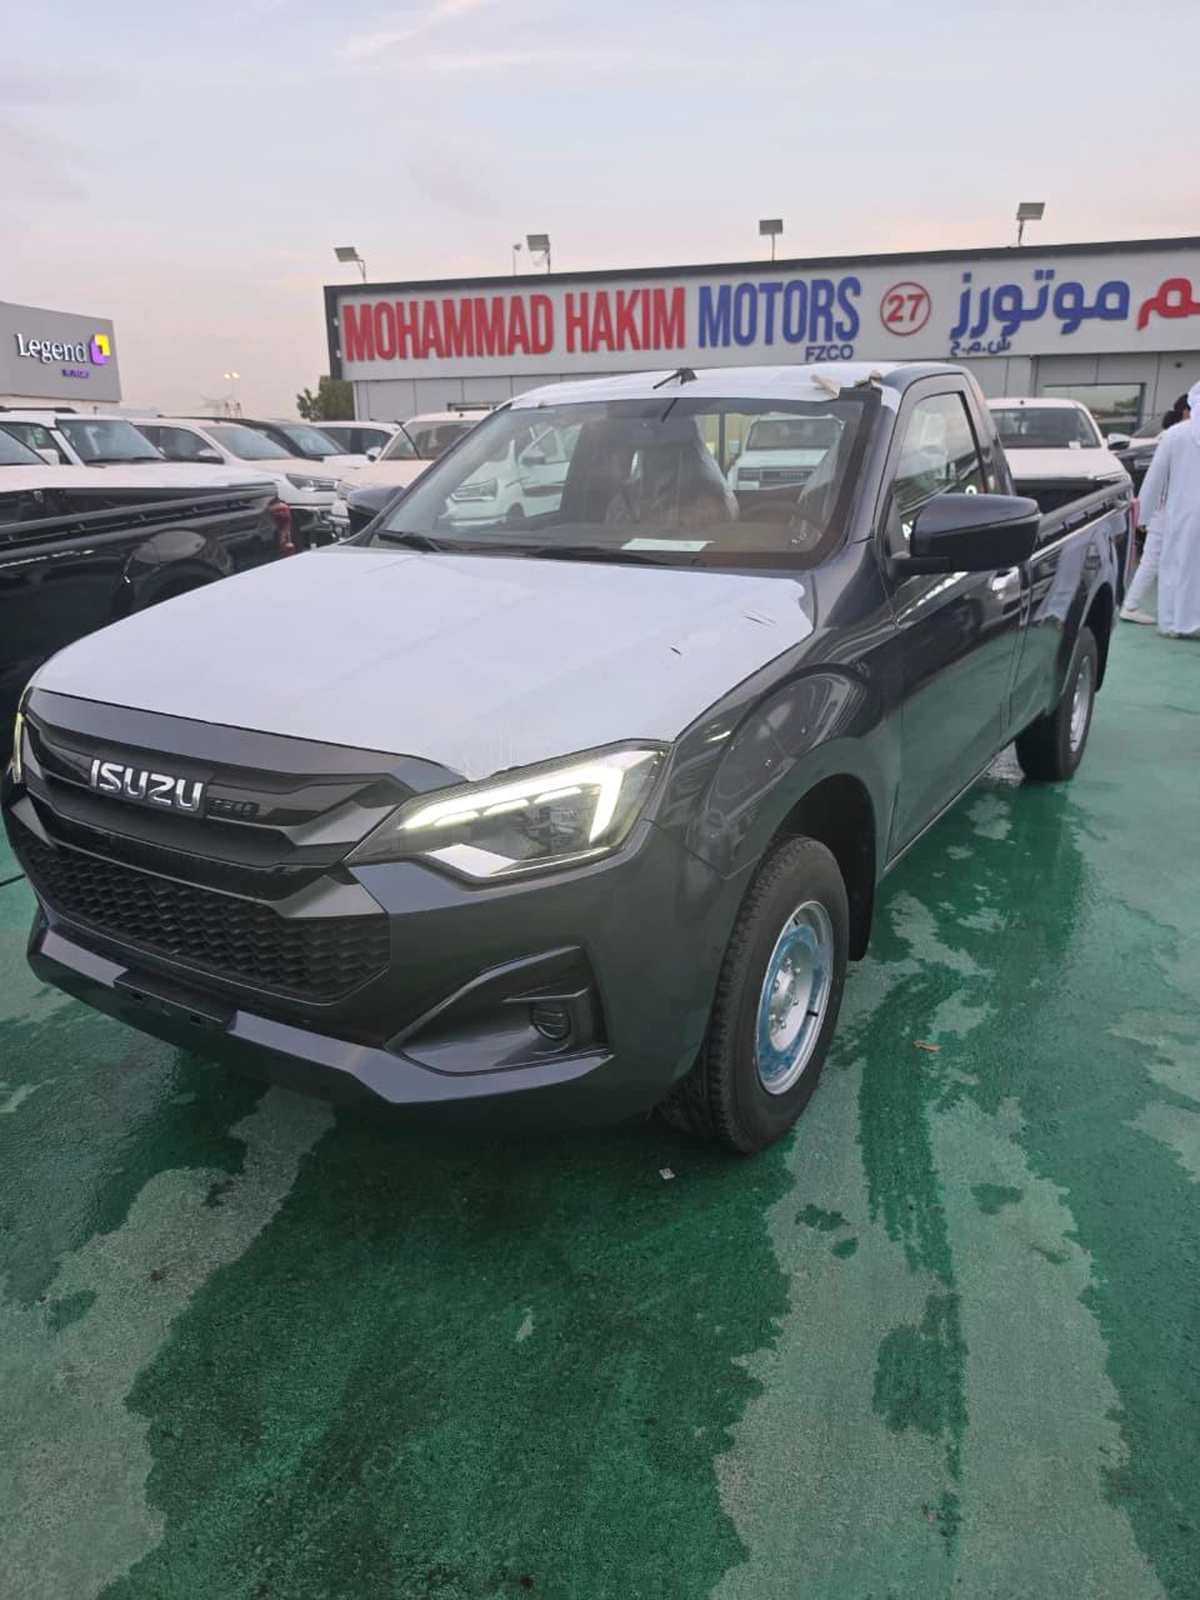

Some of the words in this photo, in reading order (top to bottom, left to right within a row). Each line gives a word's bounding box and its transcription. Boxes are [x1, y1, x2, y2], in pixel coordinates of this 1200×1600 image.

[342, 294, 554, 362] MOHAMMAD
[565, 287, 685, 354] HAKIM
[698, 276, 861, 349] MOTORS
[887, 294, 925, 323] 27
[949, 269, 1131, 340] موتورز
[15, 332, 88, 364] Legend
[804, 344, 855, 362] FZCO
[90, 759, 204, 812] ISUZU
